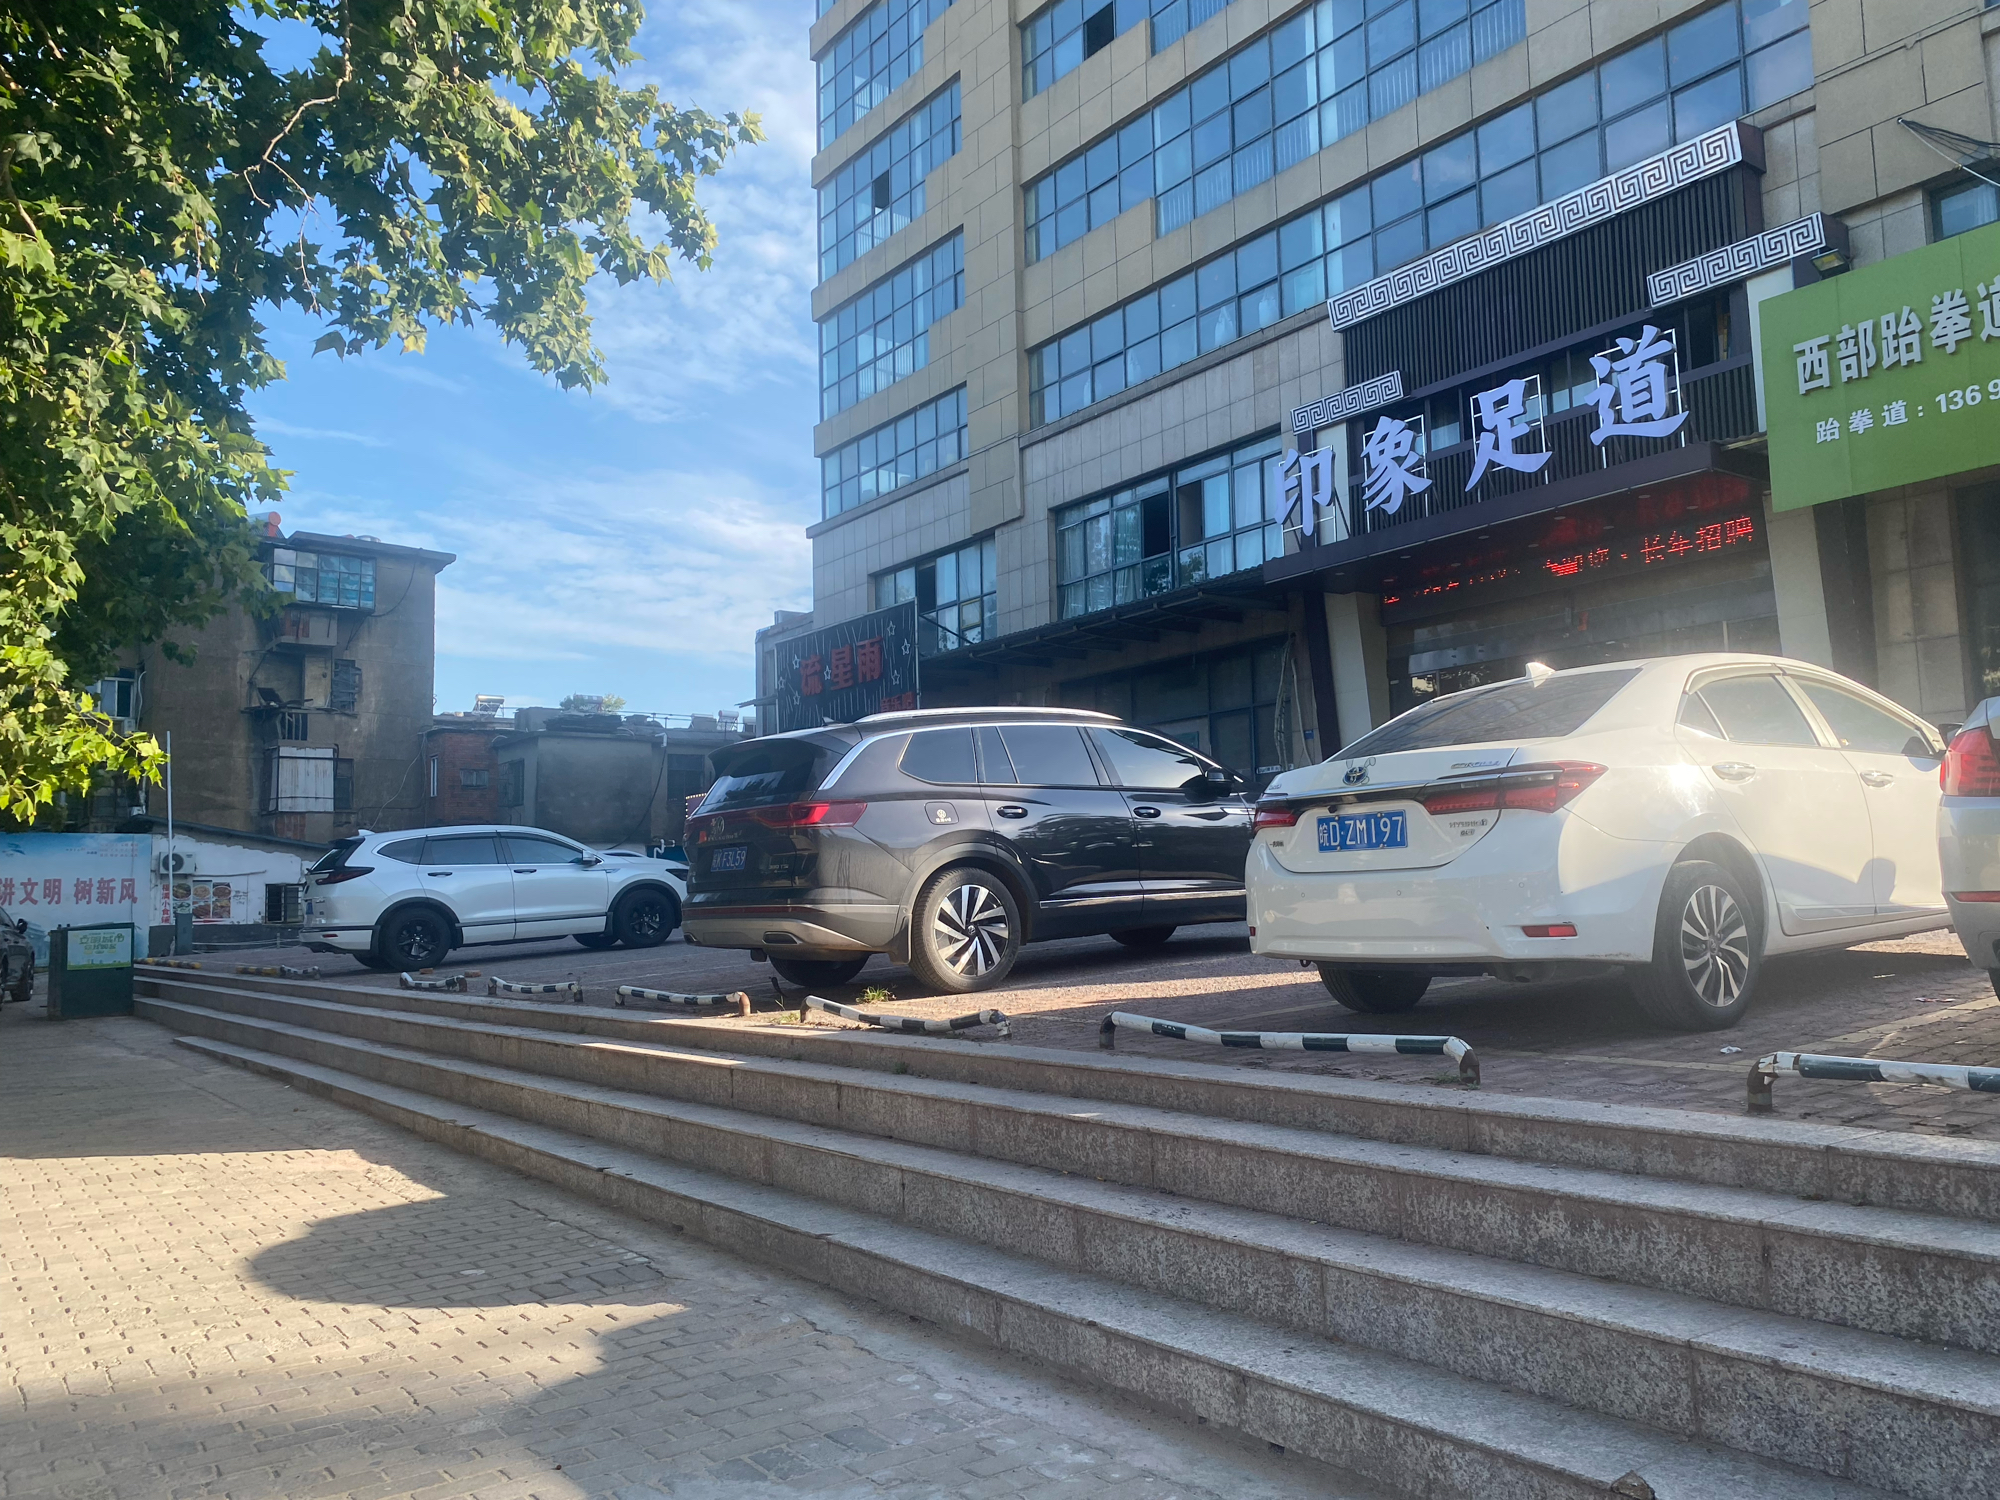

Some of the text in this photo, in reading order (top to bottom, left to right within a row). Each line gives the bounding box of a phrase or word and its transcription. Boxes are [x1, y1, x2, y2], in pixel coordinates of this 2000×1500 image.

[1793, 275, 2000, 395] 西部跆拳道
[1274, 324, 1689, 537] 印象足道
[799, 634, 884, 696] 流星雨
[74, 877, 138, 905] 树新风
